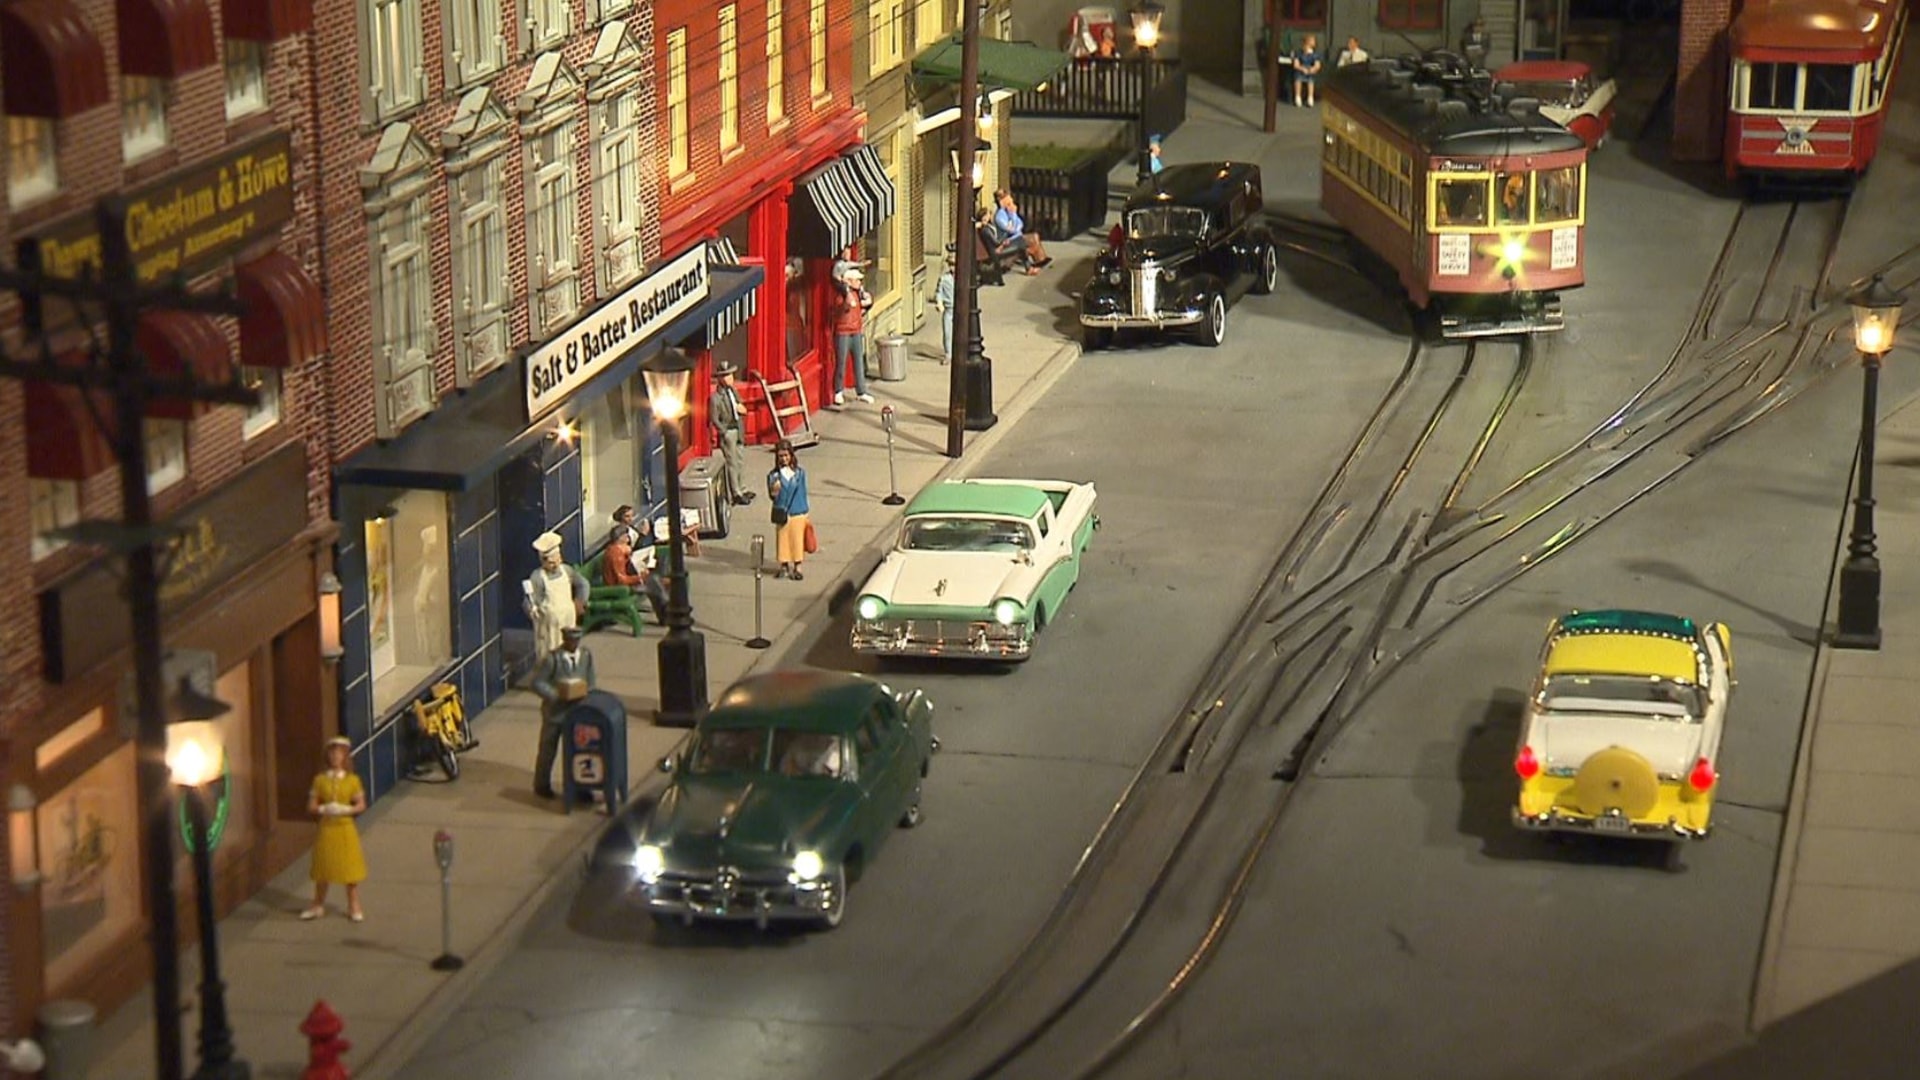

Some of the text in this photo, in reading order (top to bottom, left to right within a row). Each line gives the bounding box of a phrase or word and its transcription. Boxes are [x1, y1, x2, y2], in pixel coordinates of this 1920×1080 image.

[218, 168, 234, 210] &
[236, 152, 289, 203] Howe
[532, 259, 702, 399] Salt & Batter Restaurant
